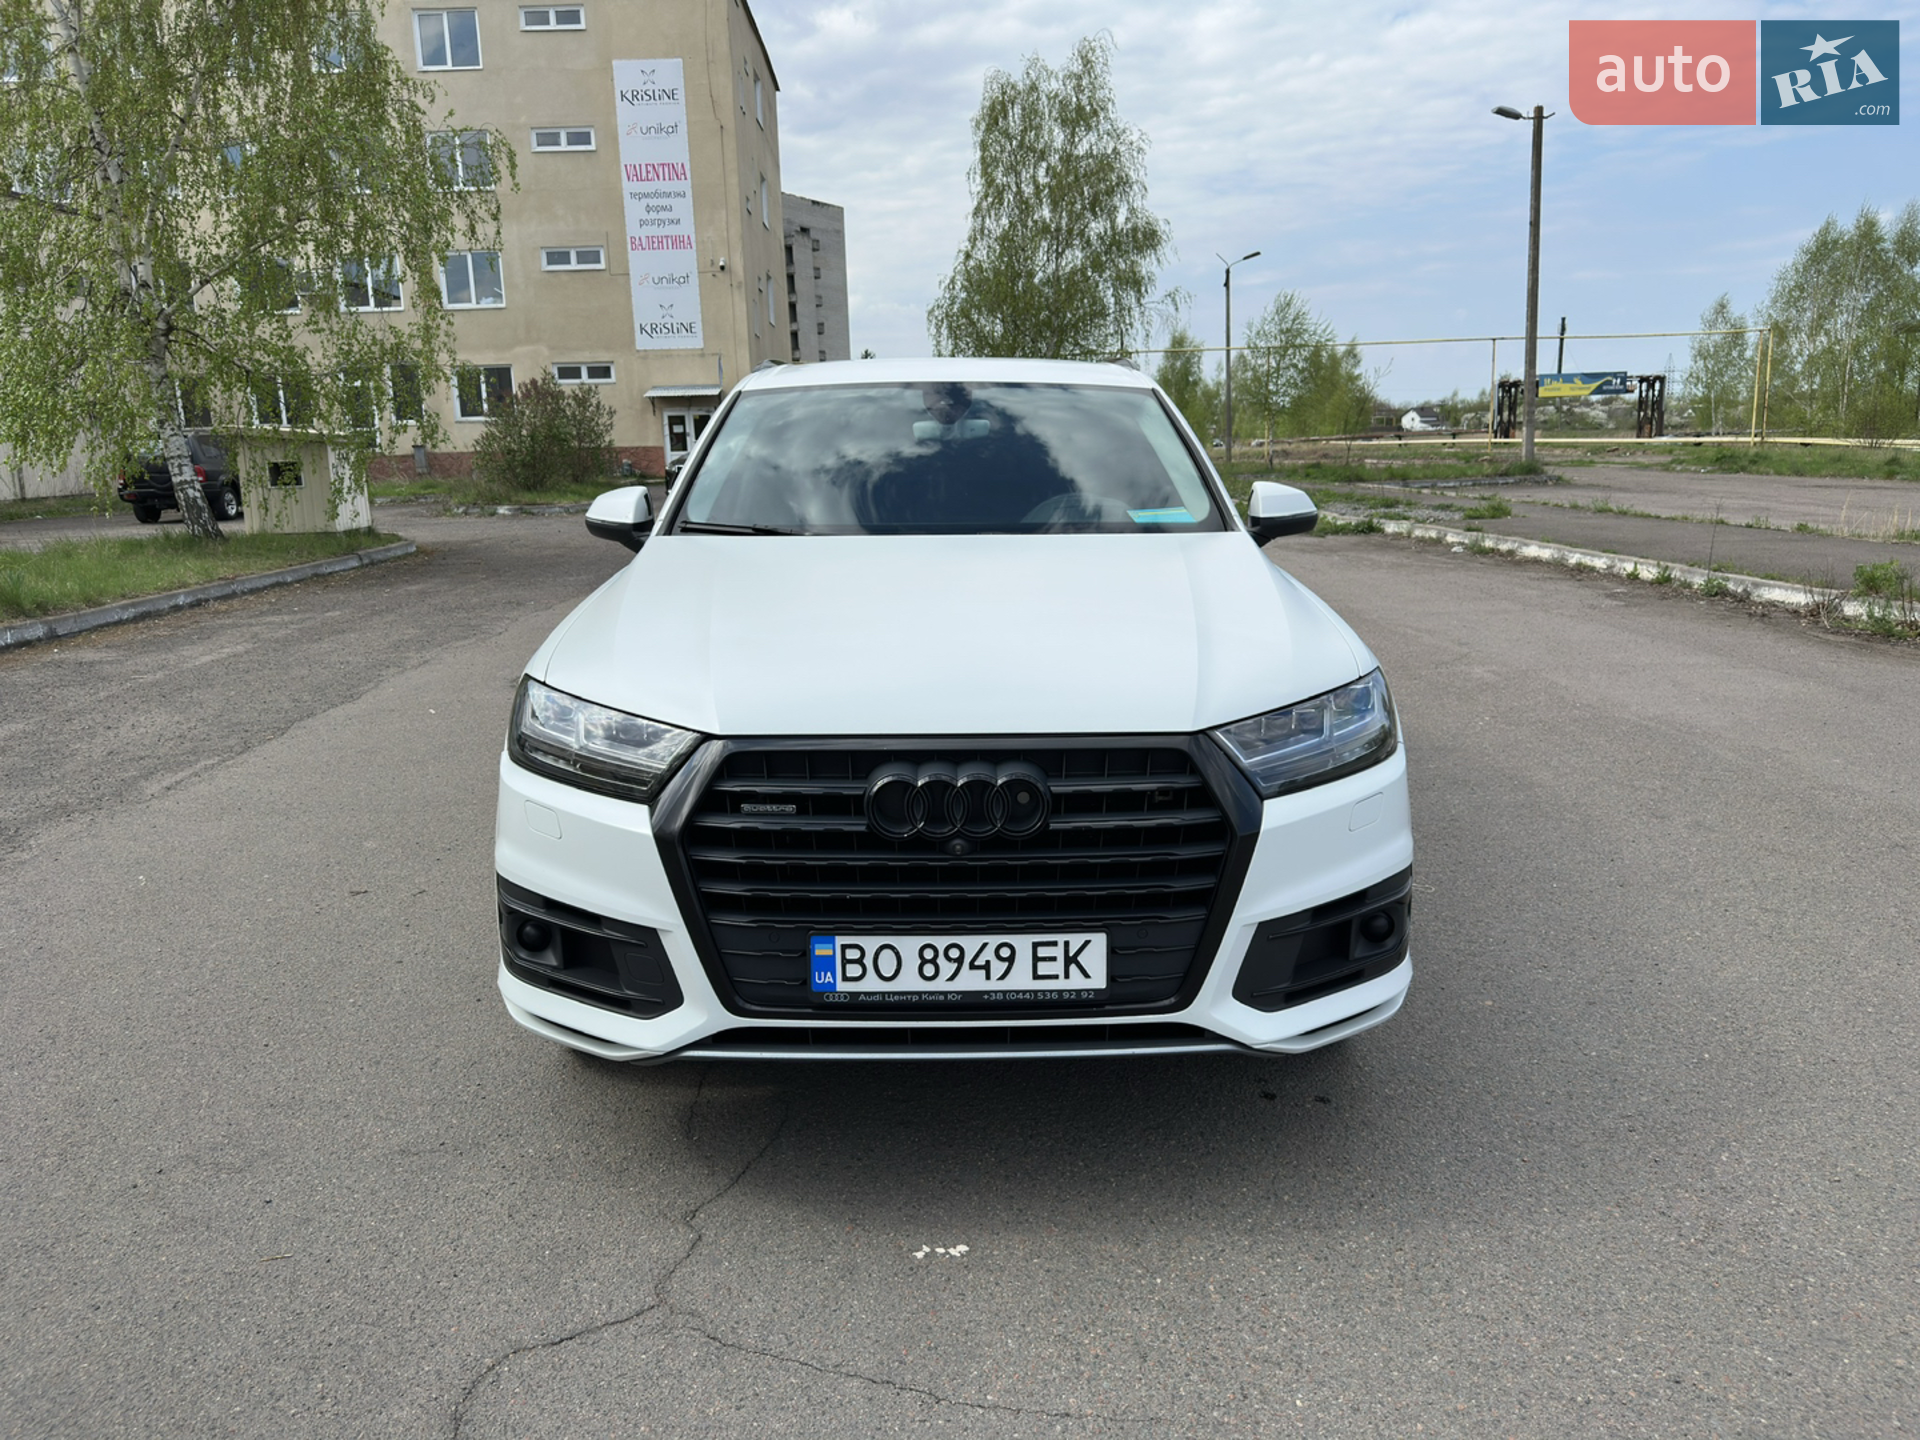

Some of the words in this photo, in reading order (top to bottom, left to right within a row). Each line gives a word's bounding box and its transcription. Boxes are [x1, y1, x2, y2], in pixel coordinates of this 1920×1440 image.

[639, 121, 678, 137] unikat
[624, 162, 688, 182] VALENTINA
[629, 189, 686, 202] термобілизна
[645, 203, 673, 215] форма
[639, 217, 681, 229] розгрузки
[630, 234, 693, 251] ВАЛЕНТИНА
[651, 272, 690, 287] unikat
[840, 943, 903, 982] BO
[918, 942, 1017, 982] 8949
[1031, 939, 1093, 981] EK
[815, 971, 834, 984] UA
[858, 993, 882, 1001] Audi
[885, 993, 919, 1002] Центр
[922, 992, 945, 1001] Київ
[947, 992, 962, 1001] Юг
[982, 991, 1004, 1000] +38
[1005, 991, 1034, 1000] (044)
[1037, 991, 1059, 1000] 536
[1062, 990, 1077, 999] 92
[1080, 990, 1095, 999] 92
